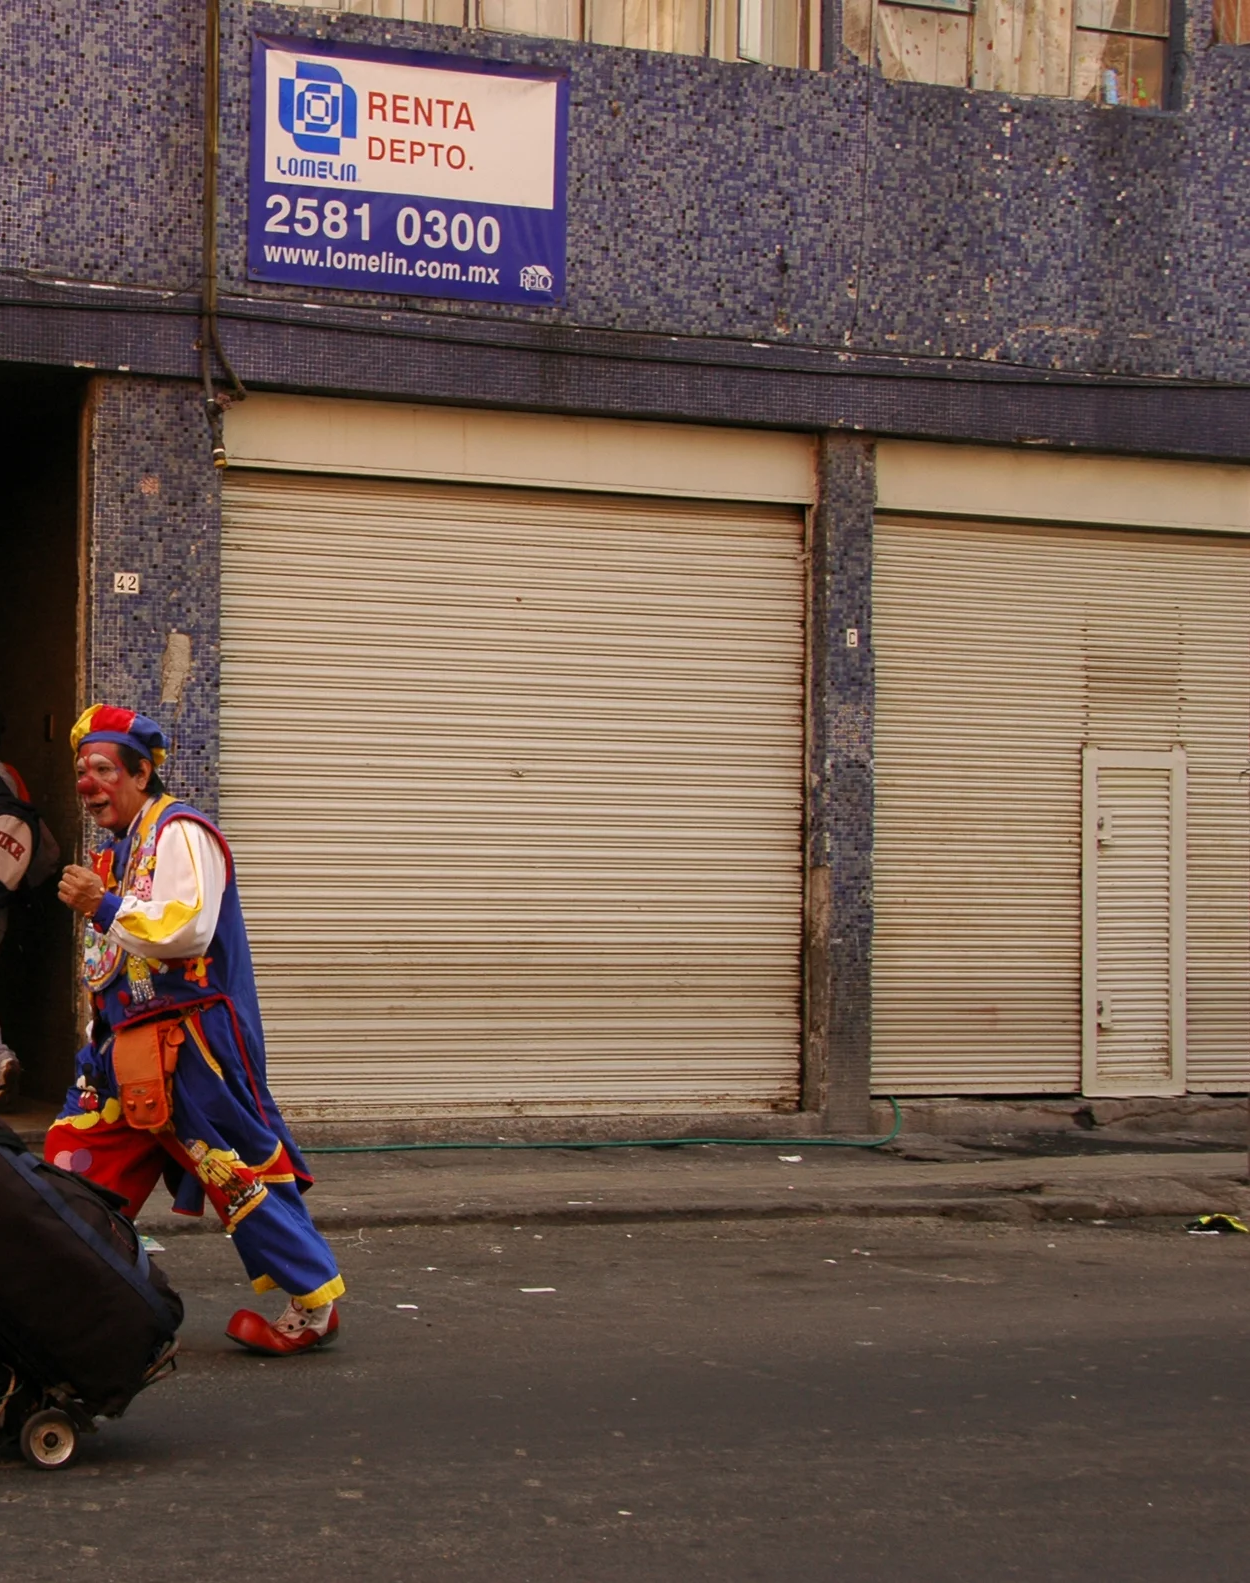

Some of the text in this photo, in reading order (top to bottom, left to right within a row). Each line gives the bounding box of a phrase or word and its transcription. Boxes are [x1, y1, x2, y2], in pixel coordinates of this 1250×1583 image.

[368, 91, 476, 132] RENTA
[277, 156, 358, 182] LOMELIN
[367, 136, 474, 171] DEPTO.
[264, 194, 501, 254] 2581 0300
[264, 244, 500, 285] www.lomelin.com.mx
[116, 575, 136, 591] 42
